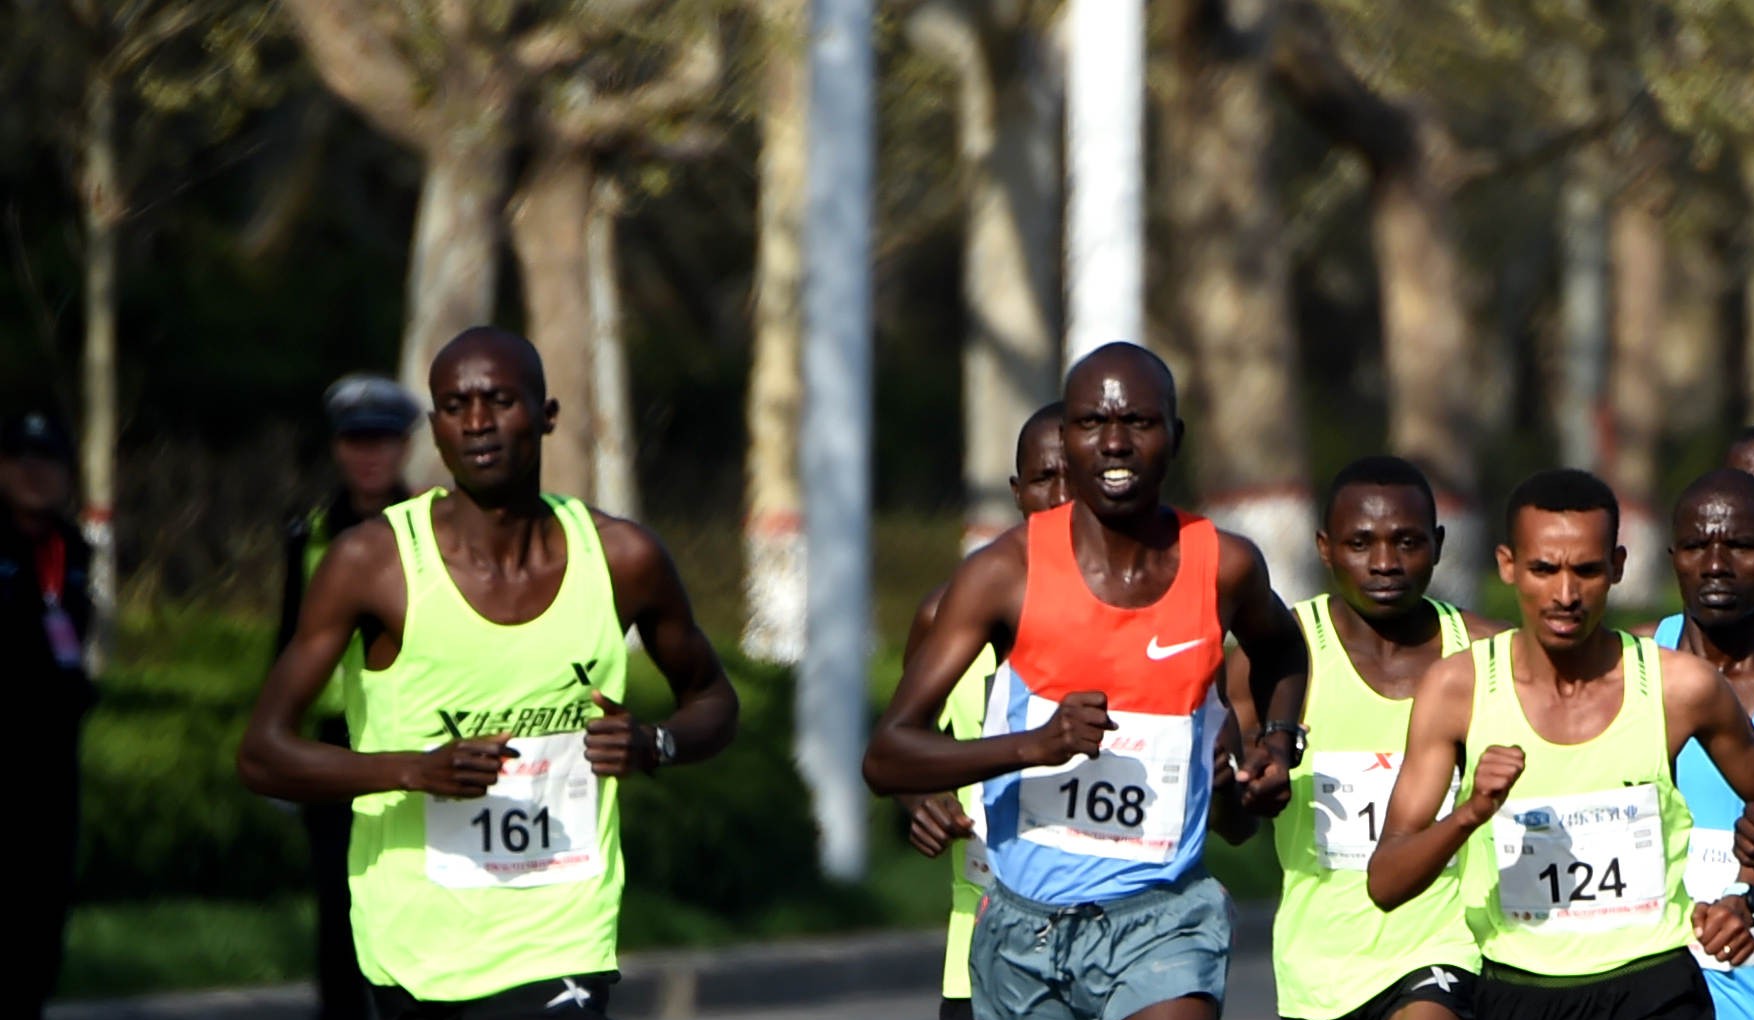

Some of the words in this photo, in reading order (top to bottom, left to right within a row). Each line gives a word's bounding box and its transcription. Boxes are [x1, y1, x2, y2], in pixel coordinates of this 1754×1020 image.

[1060, 777, 1146, 828] 168
[471, 807, 550, 853] 161
[1539, 857, 1627, 905] 124
